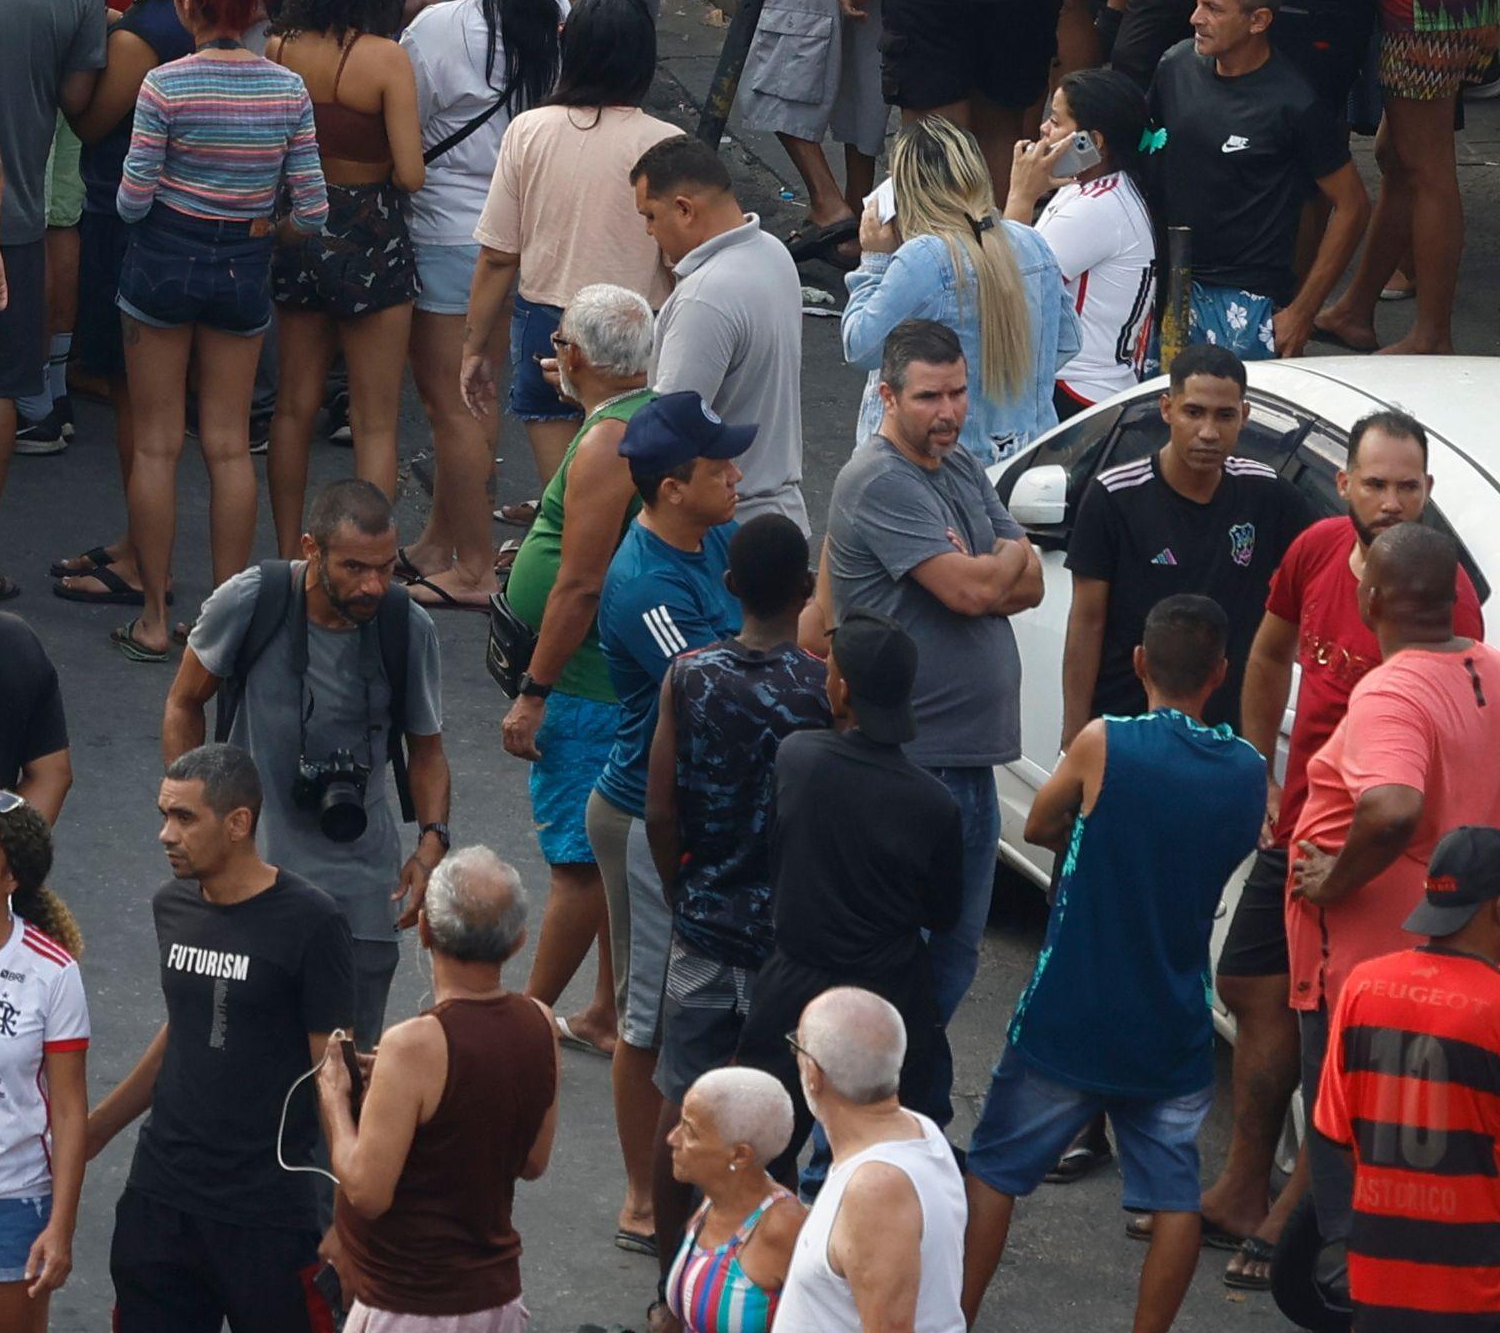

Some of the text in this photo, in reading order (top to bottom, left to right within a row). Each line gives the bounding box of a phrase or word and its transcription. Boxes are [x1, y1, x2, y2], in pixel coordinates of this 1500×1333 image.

[167, 942, 250, 981] FUTURISM
[1357, 978, 1492, 1014] PEUGEOT
[1368, 1029, 1450, 1168] 10
